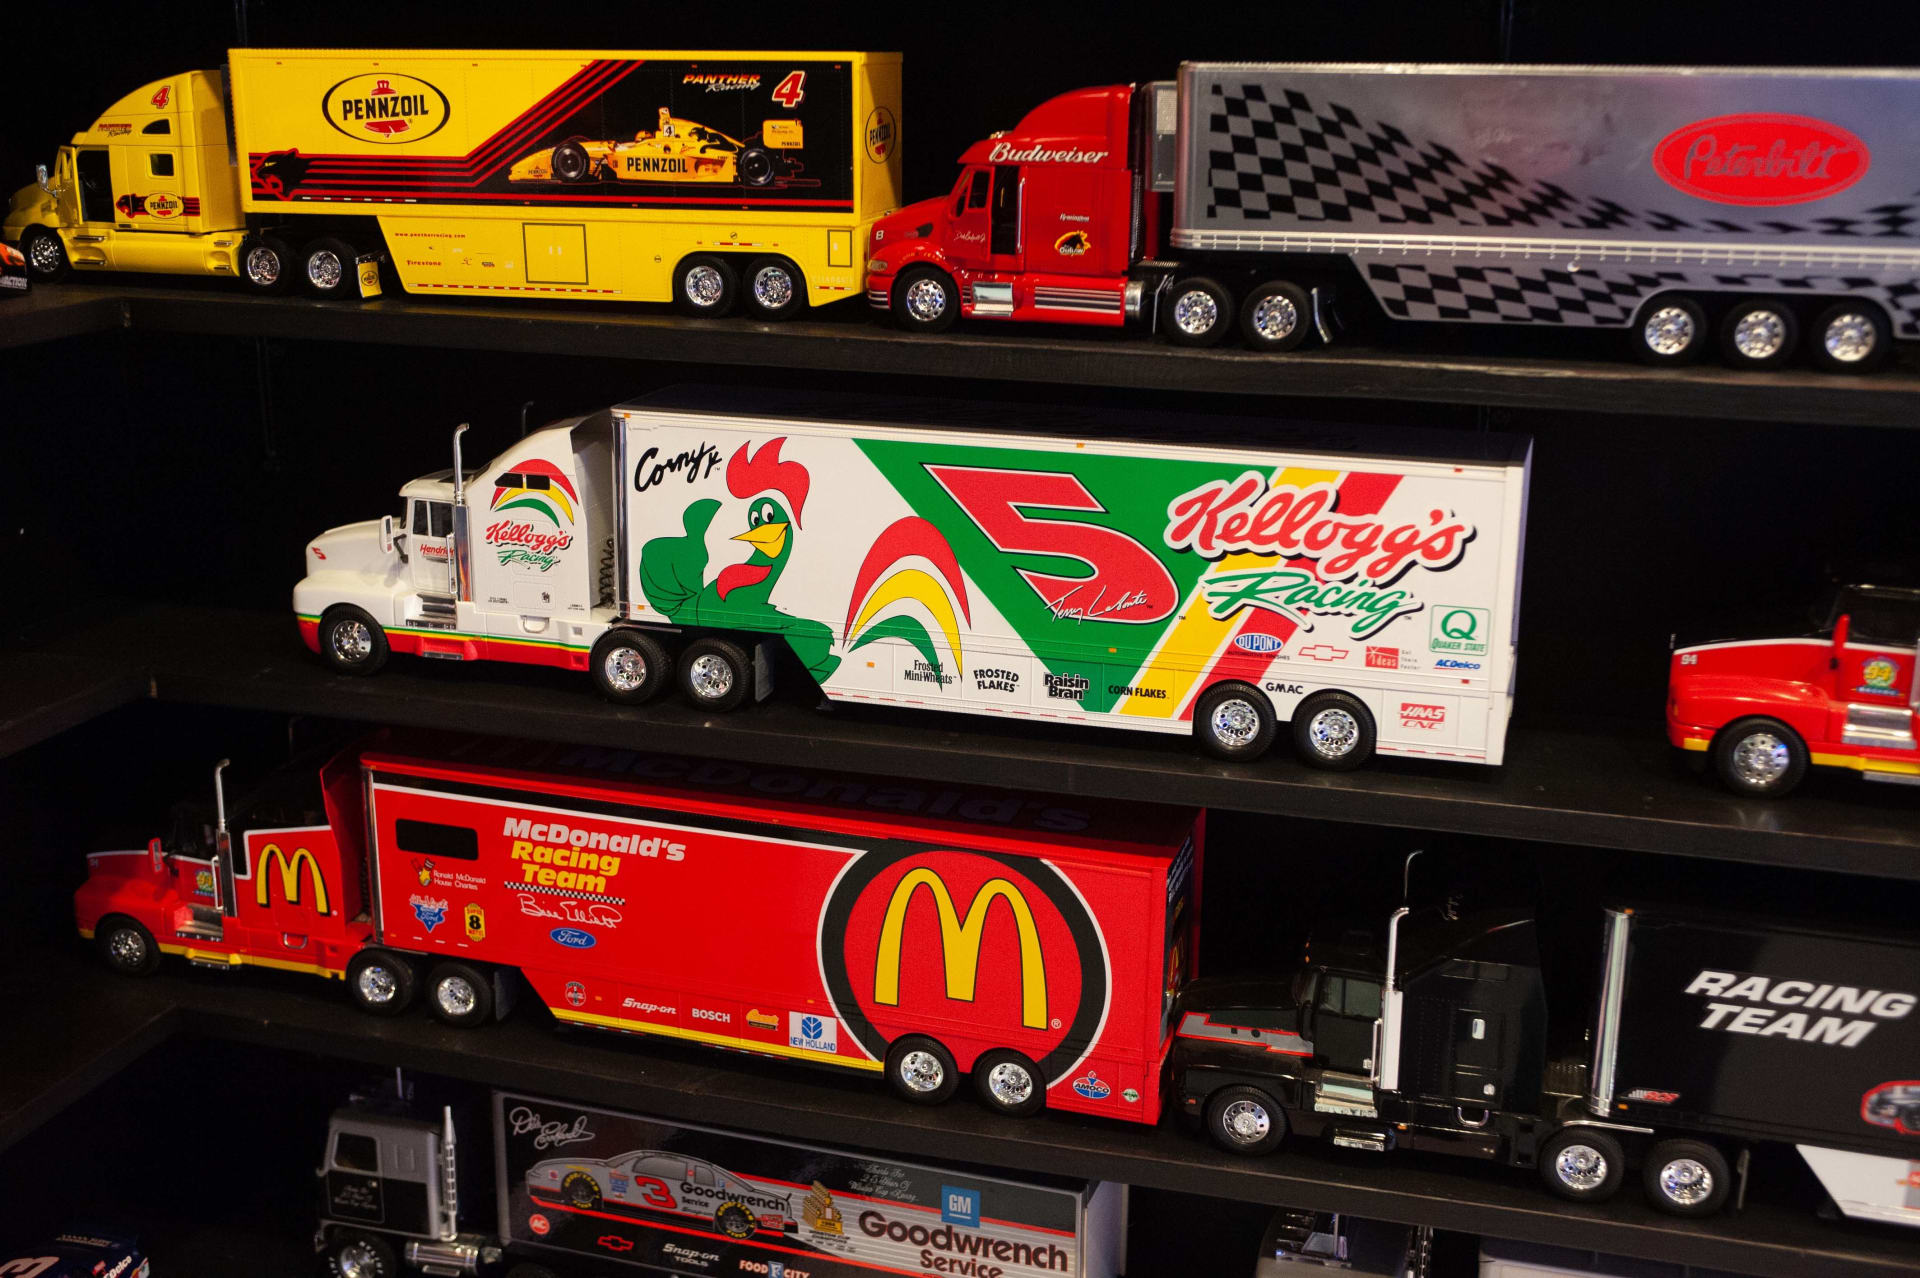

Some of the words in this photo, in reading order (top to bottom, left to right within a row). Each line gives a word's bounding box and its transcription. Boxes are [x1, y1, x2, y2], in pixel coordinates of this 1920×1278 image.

[683, 73, 761, 84] PANTHER
[772, 70, 806, 107] 4
[151, 85, 171, 109] 4
[342, 94, 429, 121] PENNZOIL
[665, 126, 673, 137] 4
[869, 122, 891, 146] PENNZOIL
[988, 142, 1108, 163] Budweiser
[1684, 134, 1850, 180] Peterbilt
[627, 157, 688, 173] PENNZOIL
[149, 200, 178, 210] PENNZOIL
[406, 259, 442, 267] Firestone
[486, 520, 572, 552] Kellogg's
[1163, 470, 1476, 586] Kellogg's
[920, 462, 1180, 624] 5
[311, 546, 326, 560] 5
[497, 549, 560, 572] Racing
[1198, 568, 1423, 639] Racing
[1441, 609, 1477, 641] Q
[1253, 635, 1279, 651] PONT
[1431, 638, 1462, 650] QUAKER
[1464, 642, 1486, 652] STATE
[914, 660, 943, 673] Frosted
[1435, 659, 1481, 670] ACDelco
[1681, 654, 1698, 665] 94
[973, 668, 1019, 682] FROSTED
[1043, 671, 1090, 689] Raisin
[1865, 665, 1893, 682] 94
[977, 680, 1015, 693] FLAKES
[1048, 686, 1084, 700] Bran
[1108, 685, 1133, 697] CORN
[1134, 687, 1167, 699] FLAKES
[1265, 682, 1304, 695] GMAC
[1400, 705, 1445, 720] HAAS
[1402, 719, 1441, 730] CNC
[503, 817, 686, 862] McDonald's
[511, 840, 621, 877] Racing
[433, 869, 454, 879] Ronald
[456, 873, 486, 884] McDonald
[434, 878, 452, 887] House
[521, 863, 607, 893] Team
[469, 914, 482, 930] 8
[557, 928, 588, 946] Ford
[1684, 970, 1919, 1018] RACING
[622, 997, 677, 1015] Snap-on
[691, 1007, 731, 1023] BOSCH
[1699, 1002, 1878, 1048] TEAM
[790, 1036, 804, 1047] NEW
[805, 1037, 836, 1052] HOLLAND
[1074, 1083, 1110, 1094] AMOCO
[635, 1175, 678, 1209] 3
[680, 1181, 785, 1212] Goodwrench
[681, 1196, 710, 1208] Service
[948, 1194, 972, 1215] GM
[858, 1209, 1068, 1272] Goodwrench
[662, 1243, 720, 1262] Snap-on
[674, 1256, 709, 1268] TOOLS
[739, 1260, 769, 1275] FOOD
[919, 1248, 1004, 1278] Service
